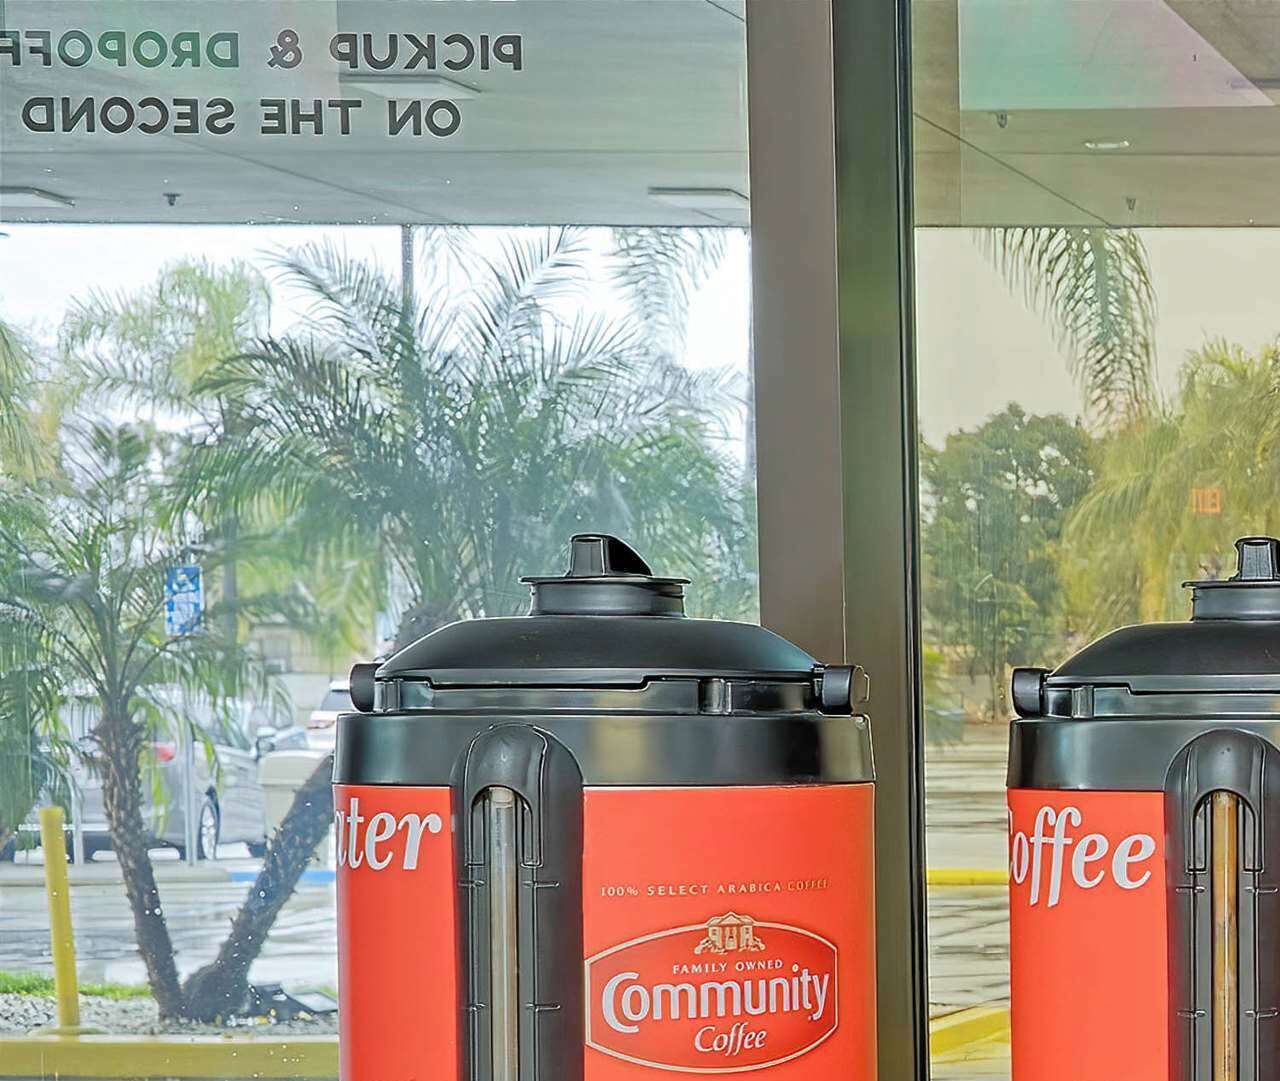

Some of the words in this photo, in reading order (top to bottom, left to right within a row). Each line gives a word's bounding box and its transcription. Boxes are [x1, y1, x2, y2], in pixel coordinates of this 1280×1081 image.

[1007, 805, 1157, 908] offee
[600, 886, 640, 898] 100%
[647, 885, 709, 897] SELECT
[716, 881, 783, 895] ARABICA
[672, 962, 728, 975] FAMILY
[735, 958, 783, 972] OWNED
[601, 963, 831, 1034] Community
[694, 1021, 768, 1057] Coffee
